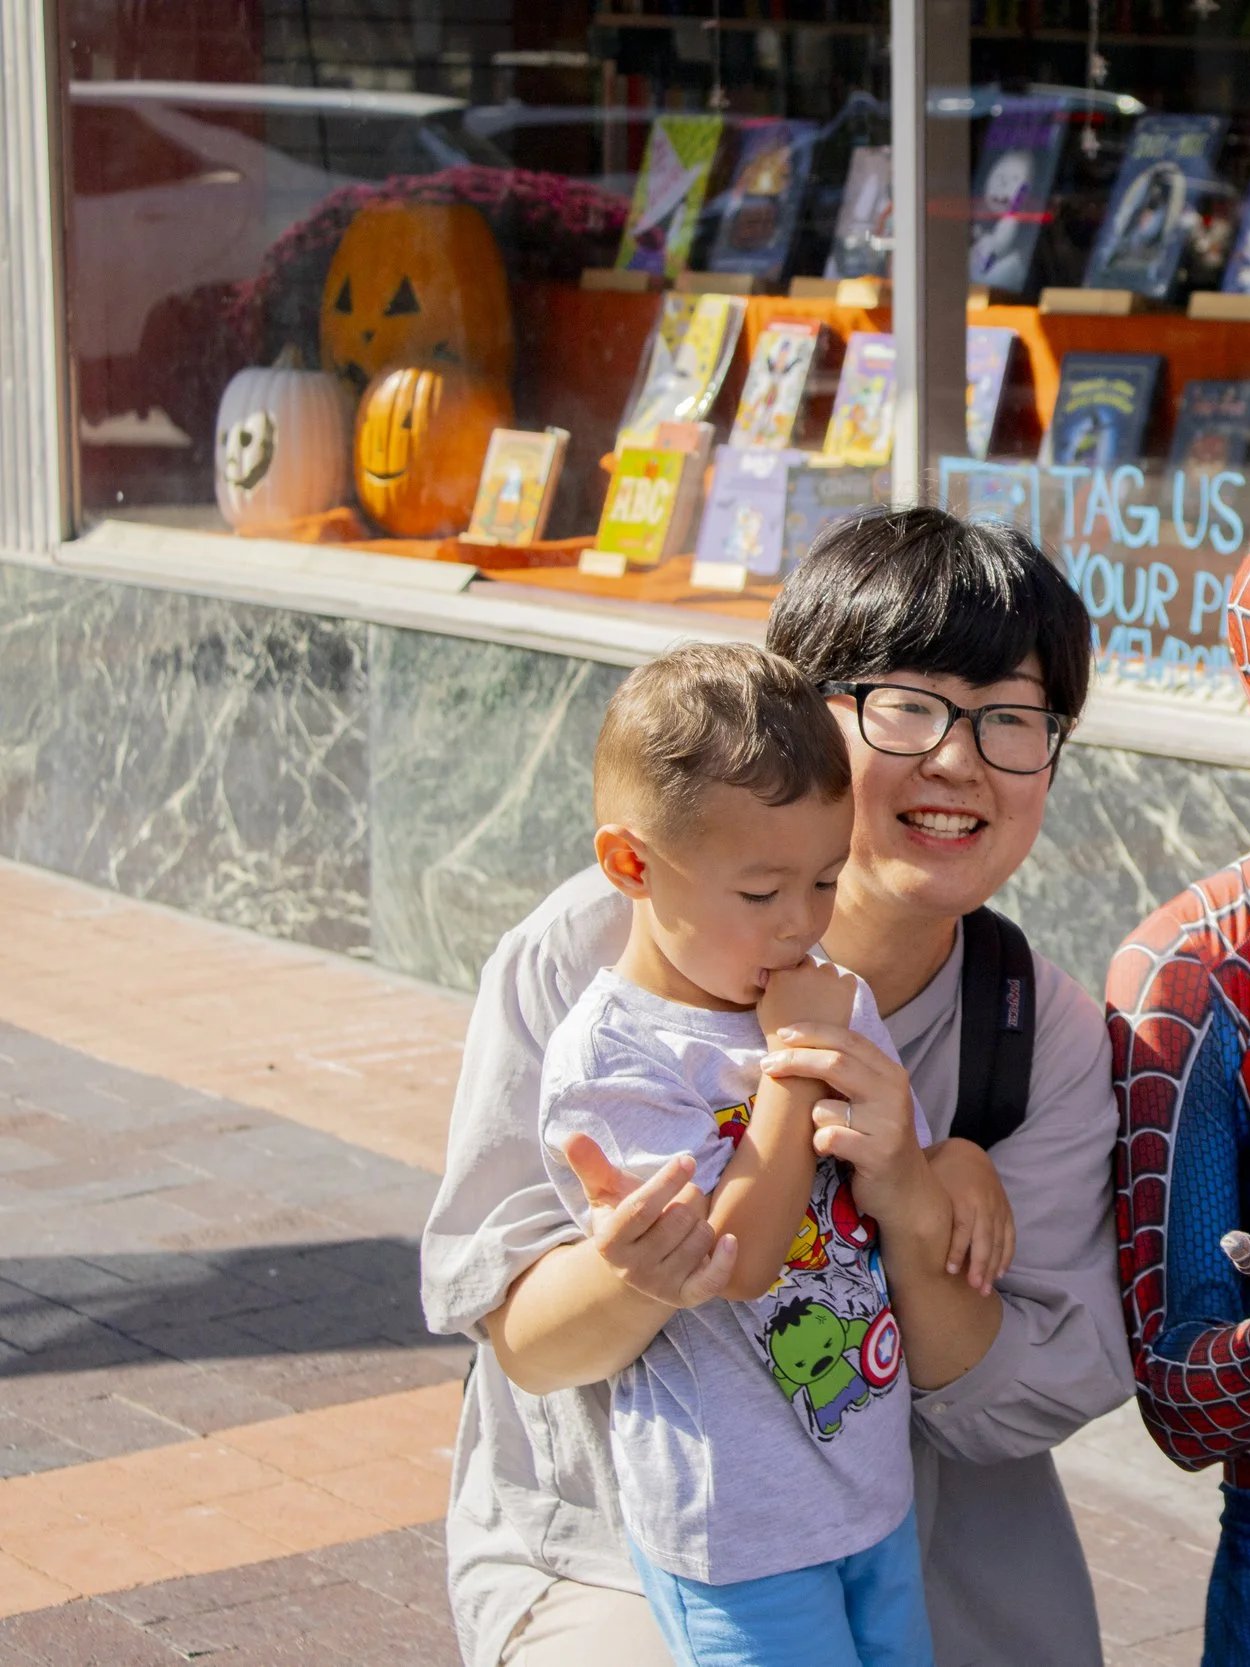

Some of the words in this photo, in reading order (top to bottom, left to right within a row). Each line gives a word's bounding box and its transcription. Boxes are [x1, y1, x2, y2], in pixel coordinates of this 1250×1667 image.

[609, 476, 672, 525] ABC
[1050, 464, 1160, 549] TAG
[1172, 470, 1246, 555] US
[1063, 543, 1179, 631] YOUR
